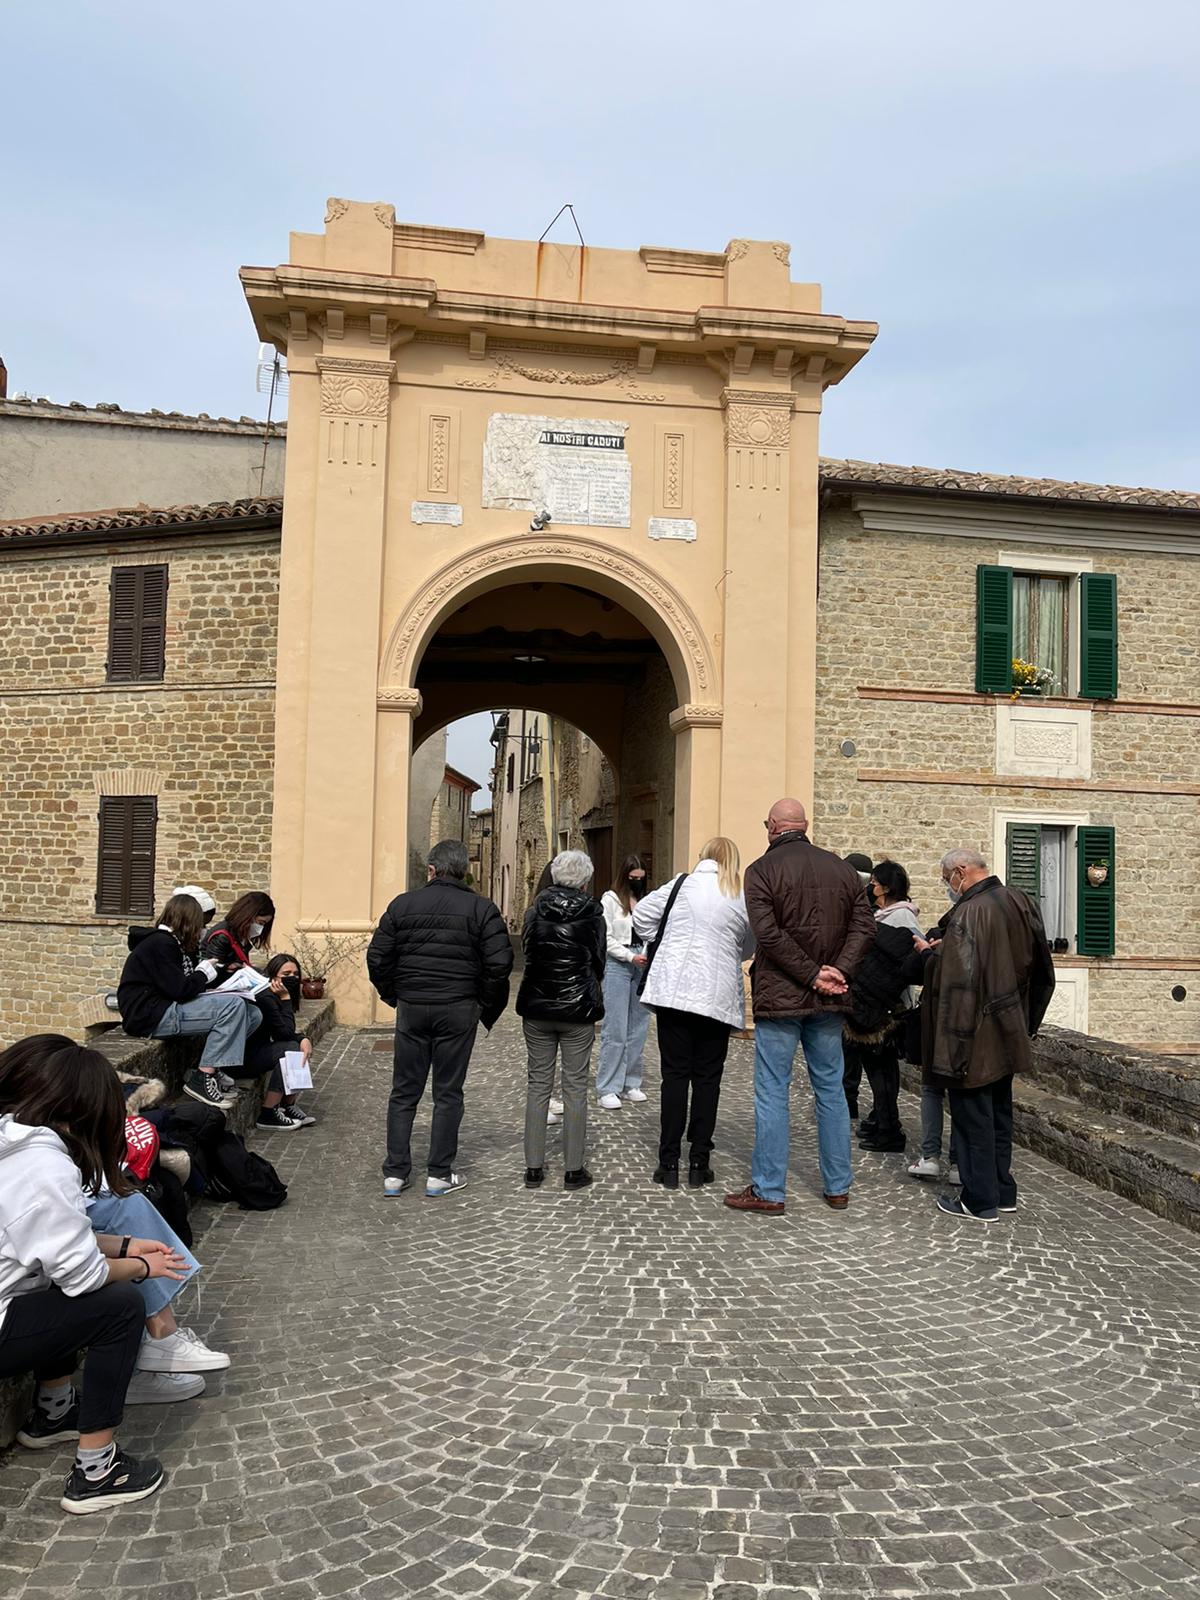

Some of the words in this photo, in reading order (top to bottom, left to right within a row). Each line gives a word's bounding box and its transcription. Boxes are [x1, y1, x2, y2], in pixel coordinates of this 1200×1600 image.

[540, 432, 551, 443] AI
[553, 433, 586, 446] NOSTRI
[587, 435, 621, 448] CADUTI
